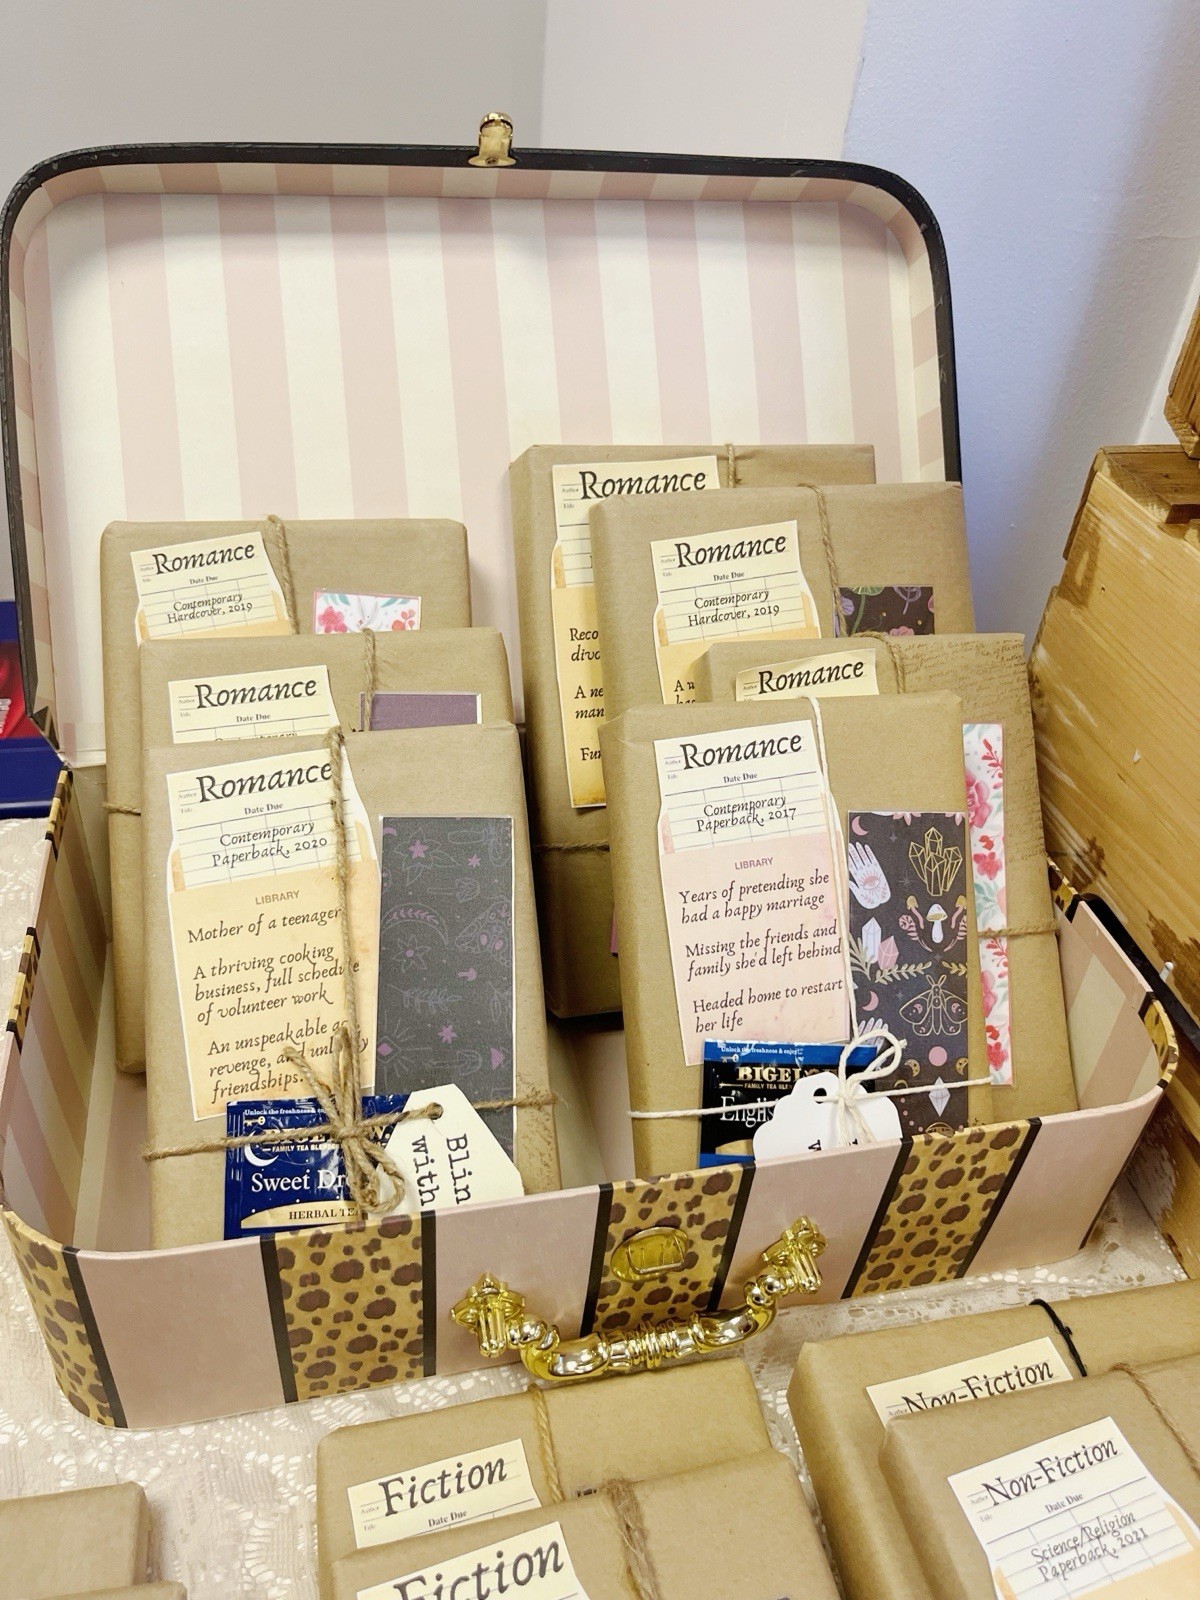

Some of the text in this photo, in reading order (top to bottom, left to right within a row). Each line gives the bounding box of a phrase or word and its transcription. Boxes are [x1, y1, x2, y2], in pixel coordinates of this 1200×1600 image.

[579, 470, 706, 500] Romance
[152, 544, 255, 575] Romance
[675, 535, 787, 568] Romance
[189, 577, 205, 585] Date
[713, 571, 745, 582] Date Due
[167, 602, 253, 624] Hardcover, 2019
[173, 592, 244, 613] Contemporary
[694, 590, 770, 609] Contemporary
[688, 604, 780, 628] Hardcover, 2019
[574, 685, 587, 699] A
[758, 661, 864, 695] Romance
[194, 679, 317, 710] Romance
[235, 713, 271, 723] Date Due
[679, 734, 802, 771] Romance
[196, 762, 332, 803] Romance
[723, 772, 758, 784] Date Due
[244, 802, 284, 815] Date Due
[696, 807, 797, 834] Paperback, 2017
[704, 796, 787, 818] Contemporary
[220, 821, 315, 847] Contemporary
[212, 837, 328, 869] Paperback, 2020
[734, 857, 774, 871] LIBRARY
[255, 890, 300, 906] LIBRARY
[679, 868, 829, 904] Years of pretending she
[681, 894, 825, 924] had a happy marriage
[188, 906, 343, 943] Mother of a teenager
[685, 918, 838, 958] Missing the friends and
[193, 943, 334, 981] A thriving cooking
[687, 937, 843, 982] family she'd left behind
[195, 980, 261, 1001] business,
[265, 968, 293, 994] full
[693, 979, 844, 1014] Headed home to restart
[197, 982, 334, 1026] of volunteer work
[207, 1039, 230, 1056] An
[235, 1016, 328, 1052] unspeakable
[695, 1010, 743, 1034] her life
[209, 1056, 272, 1078] revenge,
[211, 1071, 304, 1105] friendships.
[244, 1108, 267, 1116] Unlock
[279, 1107, 310, 1115] freshness
[251, 1170, 311, 1193] Sweet
[411, 1135, 440, 1206] with
[289, 1210, 338, 1220] HERBAL
[379, 1457, 507, 1517] Fiction
[981, 1439, 1118, 1506] Non-Fiction
[1044, 1492, 1084, 1514] Date Due
[428, 1510, 467, 1528] Date Due
[1031, 1511, 1137, 1564] Science/Religion
[1038, 1527, 1149, 1583] Paperback, 2021
